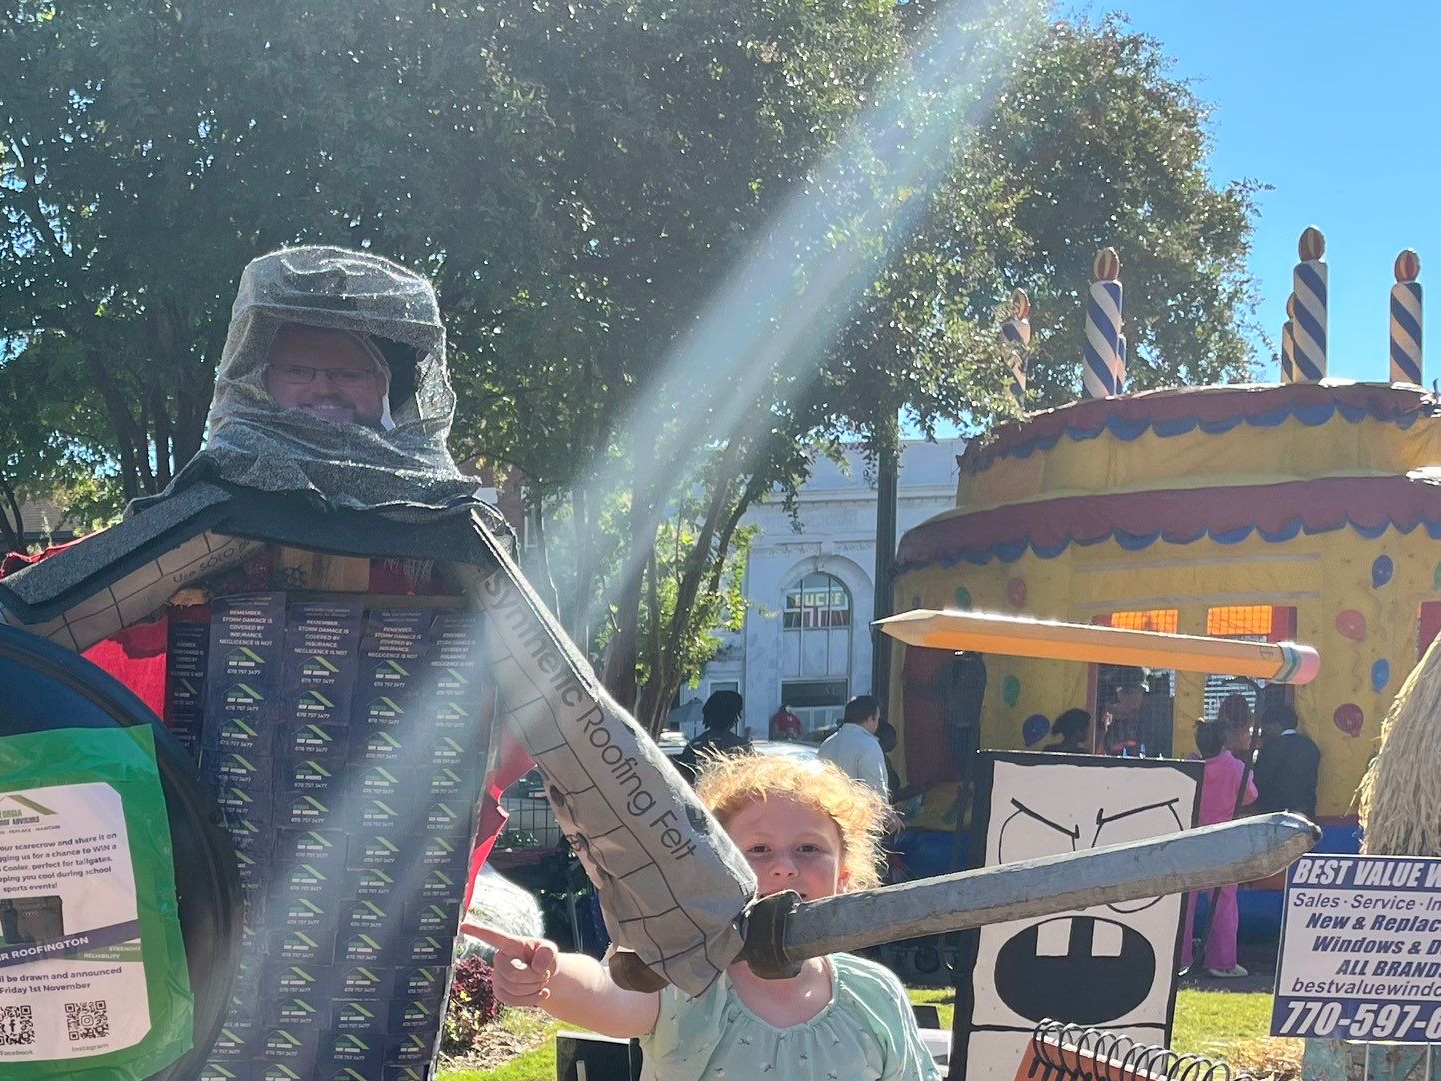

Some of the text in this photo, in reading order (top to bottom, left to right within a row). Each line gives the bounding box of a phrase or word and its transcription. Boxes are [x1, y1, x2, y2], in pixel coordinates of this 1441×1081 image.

[484, 570, 695, 861] Synthetic Roofing Felt
[15, 841, 56, 850] scarecrow
[74, 836, 97, 845] share
[52, 848, 81, 858] chance
[93, 844, 111, 853] WIN
[22, 873, 37, 882] you
[38, 871, 55, 879] cool
[56, 868, 84, 878] during
[85, 865, 112, 875] school
[32, 861, 61, 871] perfect
[62, 859, 74, 867] for
[1292, 859, 1354, 885] BEST
[1353, 860, 1425, 889] VALUE
[3, 882, 58, 893] sports events!
[1293, 892, 1341, 909] Sales
[1350, 894, 1416, 911] Service
[1305, 912, 1351, 929] New
[1352, 917, 1367, 930] &
[11, 936, 90, 960] ROOFINGTON
[1312, 935, 1405, 955] Windows
[1408, 941, 1422, 955] &
[19, 973, 49, 982] drawn
[50, 972, 69, 980] and
[70, 966, 122, 978] announced
[1335, 959, 1370, 976] ALL
[0, 982, 91, 995] Friday 1st November
[71, 1042, 109, 1052] Instagram
